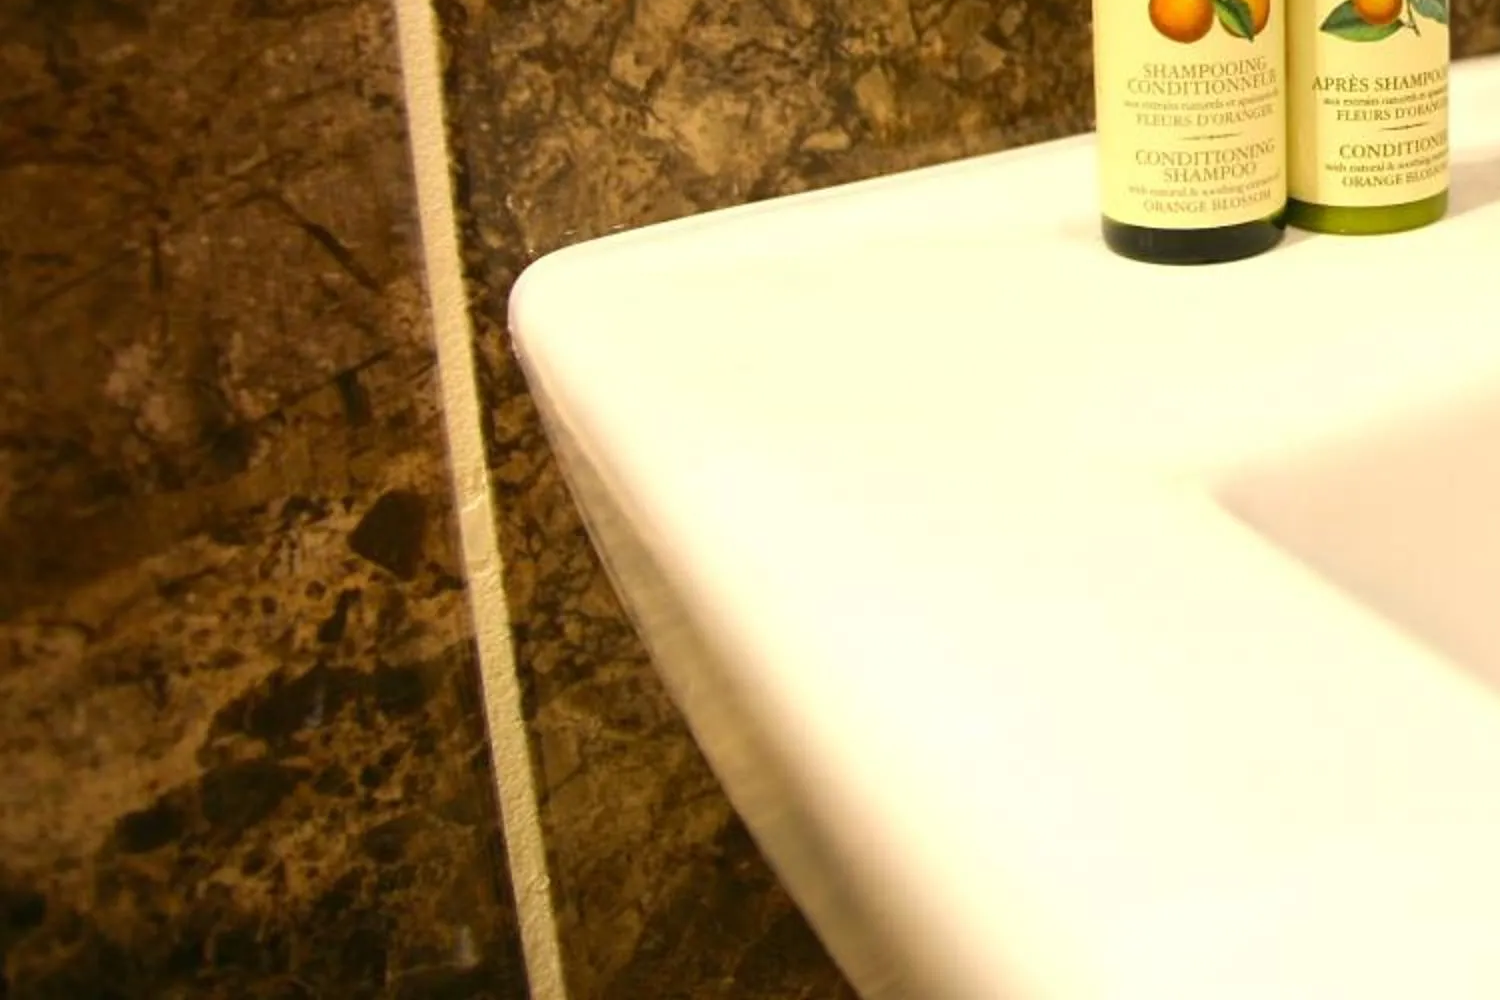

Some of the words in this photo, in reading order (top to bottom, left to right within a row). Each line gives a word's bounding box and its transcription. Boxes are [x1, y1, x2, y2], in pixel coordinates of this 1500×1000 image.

[1143, 56, 1267, 80] SHAMPOOING
[1311, 72, 1370, 93] APRÈS
[1135, 112, 1194, 128] FLEURS
[1336, 109, 1392, 122] FLEURS
[1134, 138, 1276, 167] CONDITIONING
[1163, 162, 1258, 183] SHAMPOO
[1341, 174, 1404, 188] ORANGE
[1143, 198, 1208, 214] ORANGE
